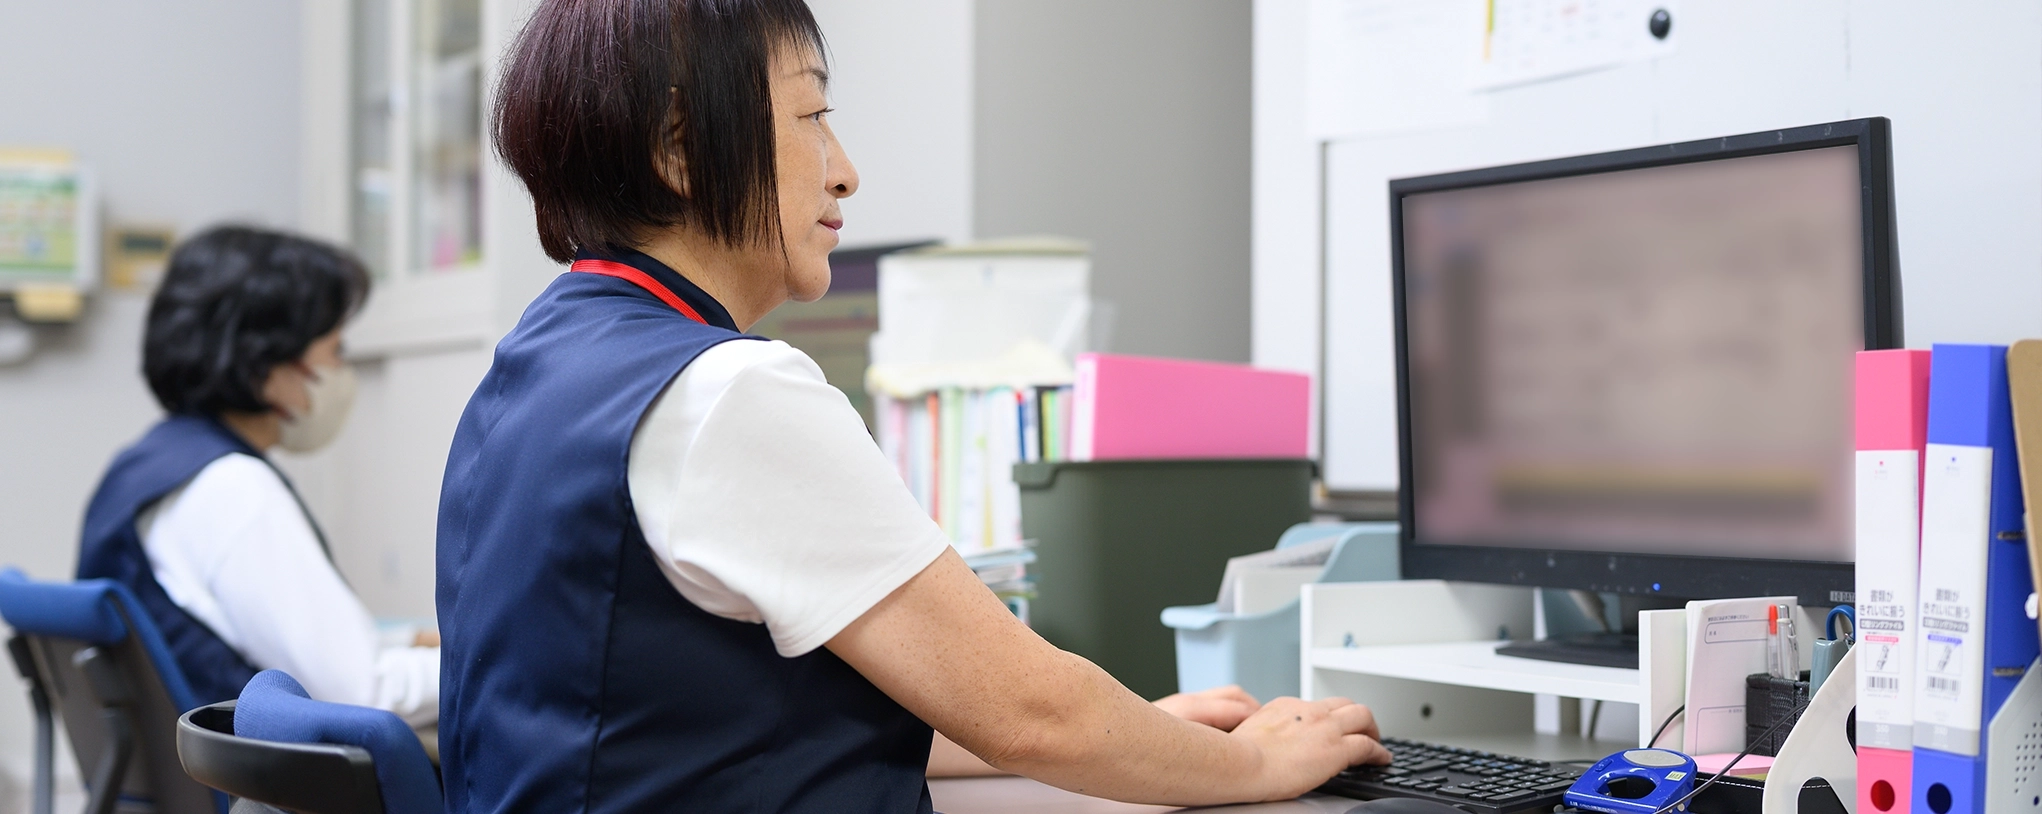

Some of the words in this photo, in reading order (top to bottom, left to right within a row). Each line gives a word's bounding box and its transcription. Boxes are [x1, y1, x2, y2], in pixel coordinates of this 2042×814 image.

[1870, 590, 1894, 602] 書類が
[1859, 605, 1905, 618] きれいに揃う
